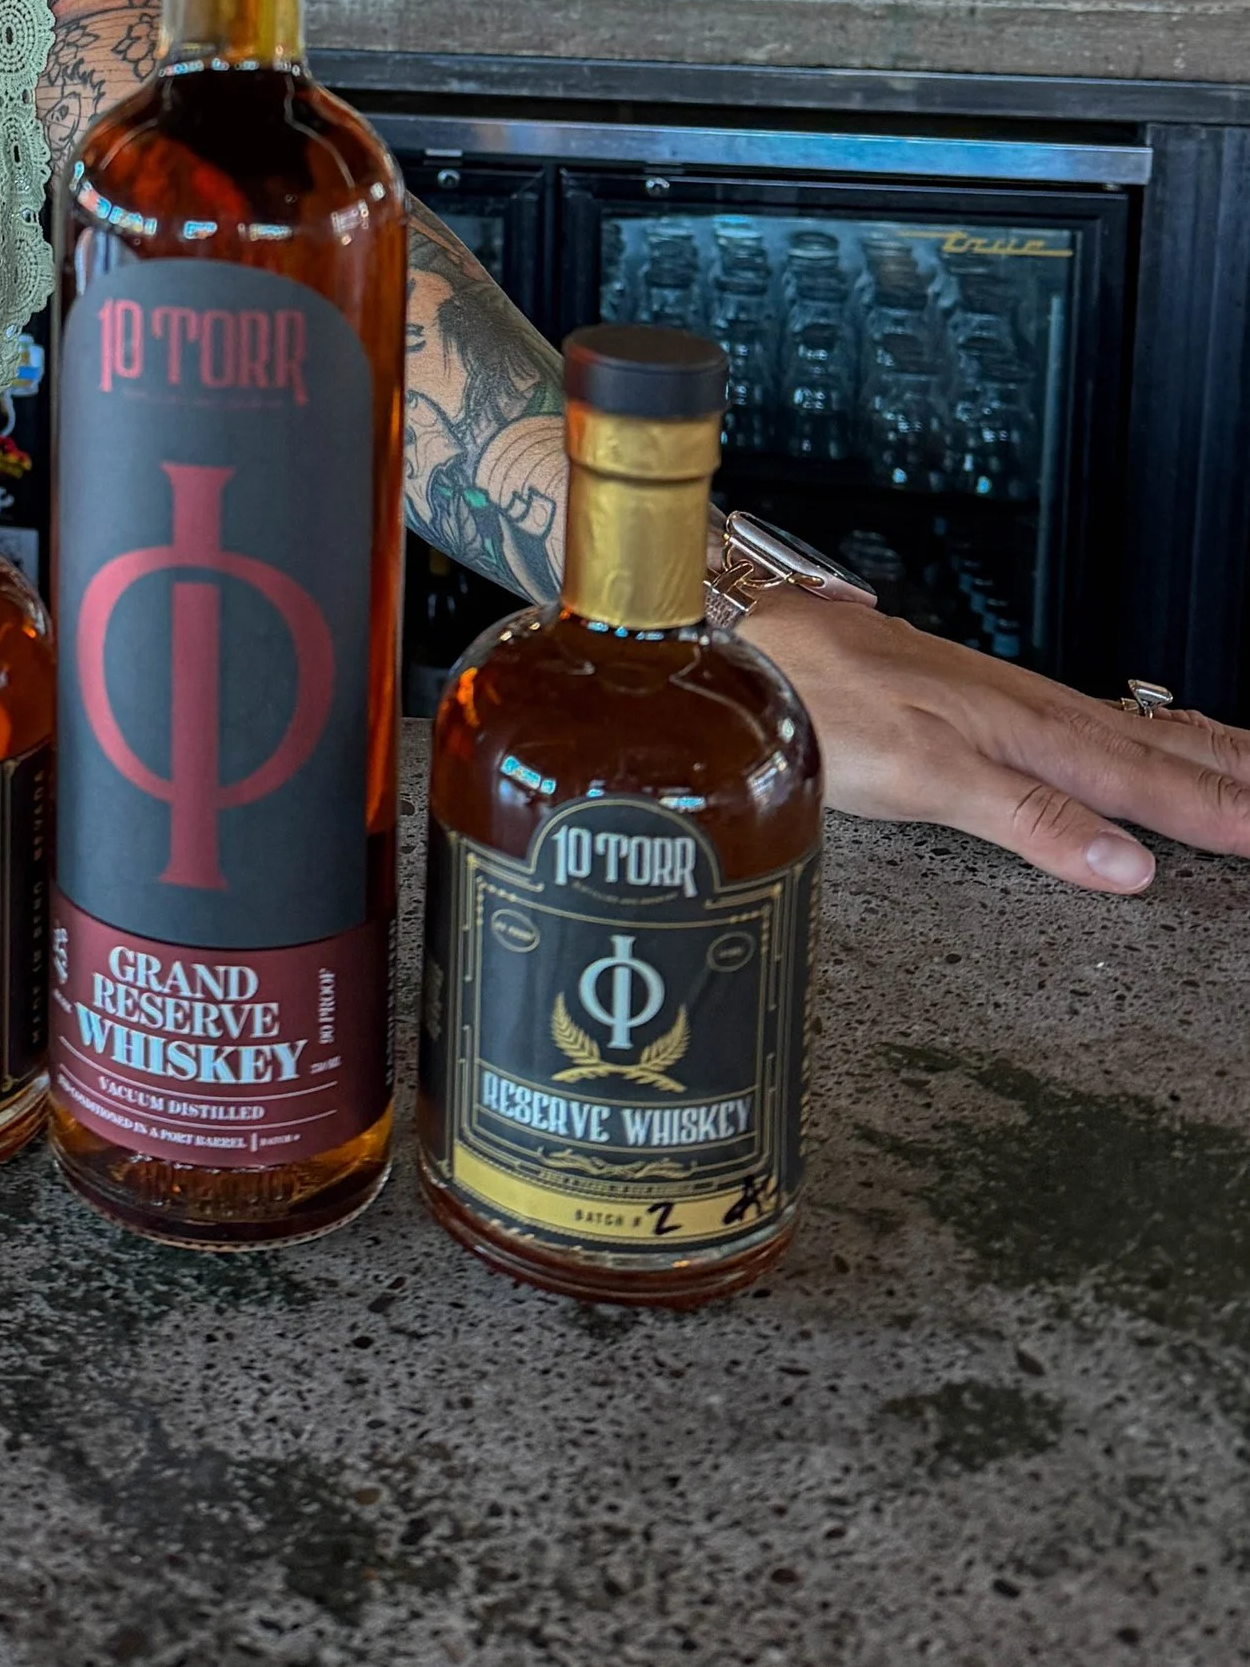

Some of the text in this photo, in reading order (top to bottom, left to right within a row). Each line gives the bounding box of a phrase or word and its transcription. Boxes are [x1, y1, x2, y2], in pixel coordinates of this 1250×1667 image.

[99, 297, 311, 407] 10 TORR
[552, 824, 699, 898] 10 TORR
[91, 971, 280, 1039] RESERVE
[107, 945, 260, 1003] GRAND
[318, 968, 336, 1023] PROOF
[73, 1001, 309, 1086] WHISKEY
[97, 1075, 165, 1113] VACUUM
[167, 1097, 266, 1122] DISTILLED
[481, 1071, 752, 1148] RESERVE WHISKEY
[194, 1135, 247, 1150] BARREL
[574, 1208, 625, 1228] BATCH
[646, 1202, 682, 1237] 2
